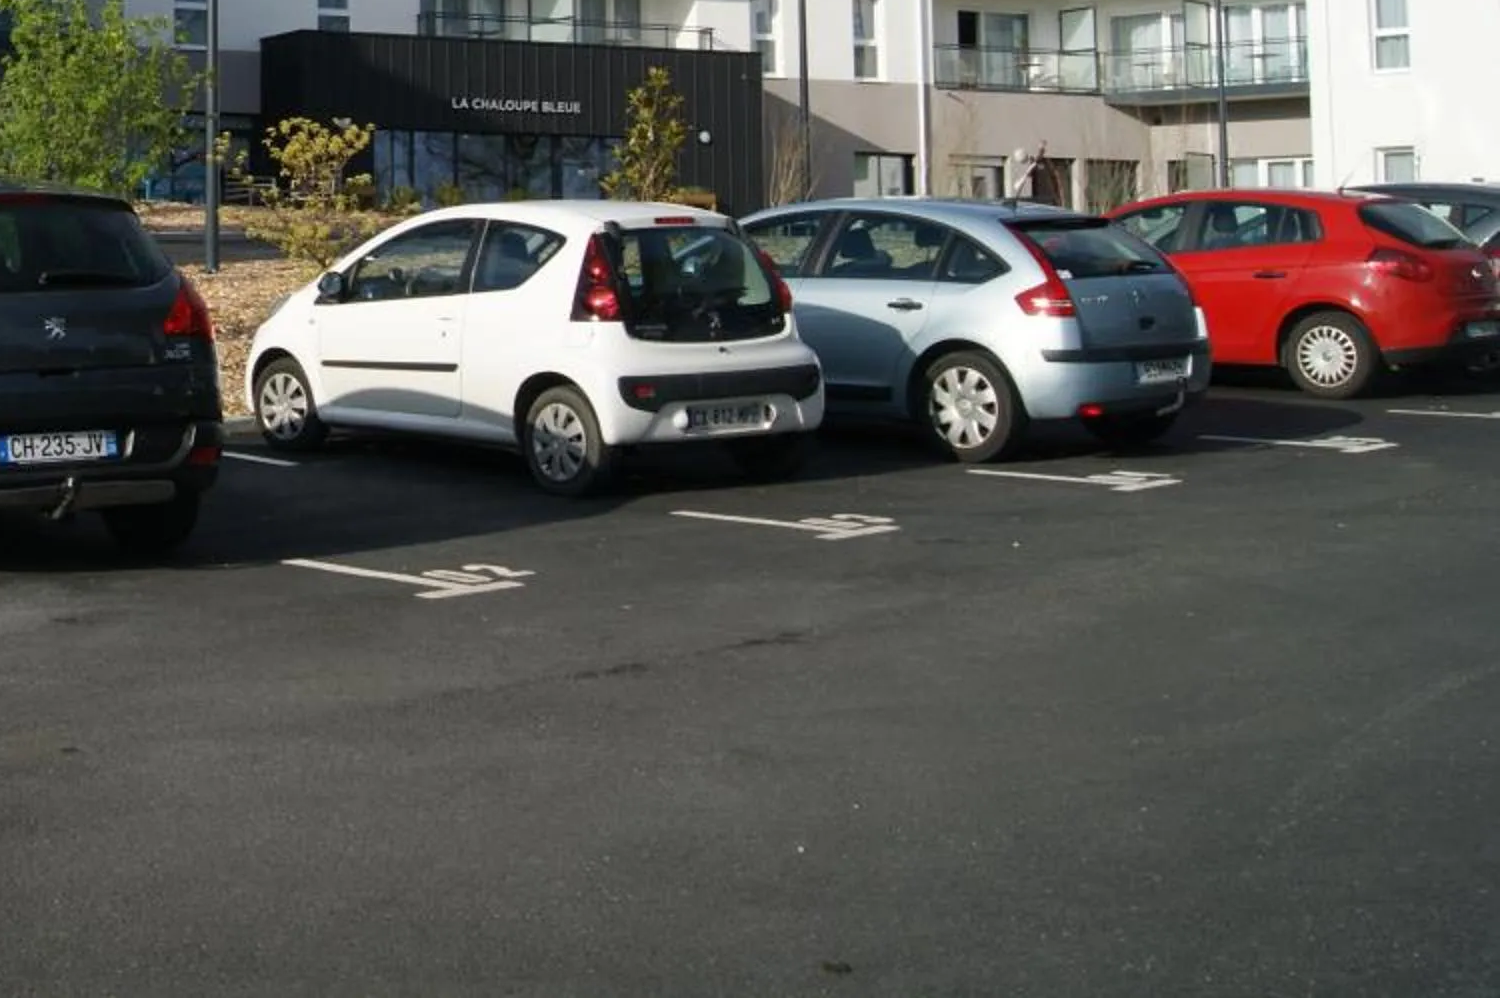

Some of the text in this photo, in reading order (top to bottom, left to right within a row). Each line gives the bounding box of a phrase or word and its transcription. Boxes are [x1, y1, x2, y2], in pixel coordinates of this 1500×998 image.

[451, 97, 581, 114] LA CHALOUPE BLEUE
[10, 433, 103, 458] CH-235-JV
